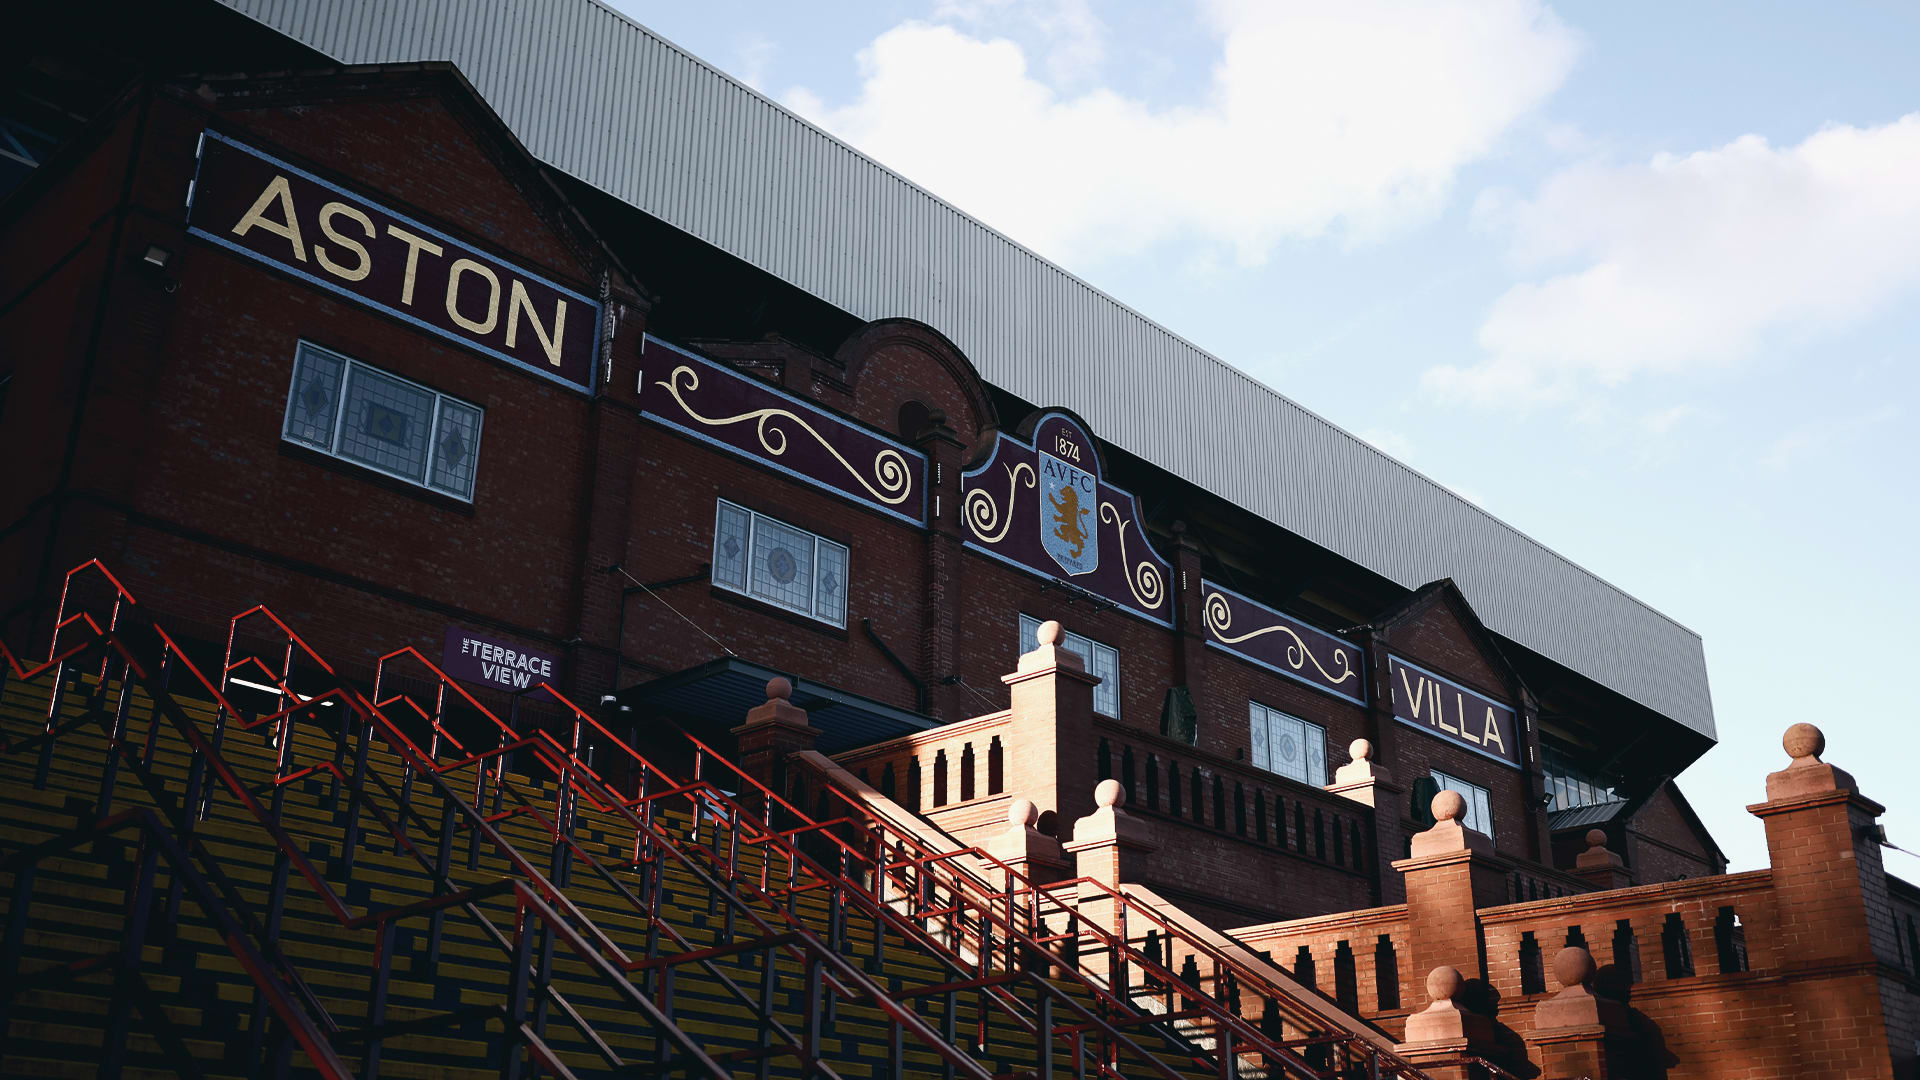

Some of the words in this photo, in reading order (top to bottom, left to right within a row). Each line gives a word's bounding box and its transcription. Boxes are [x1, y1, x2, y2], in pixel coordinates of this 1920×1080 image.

[232, 175, 567, 367] ASTON
[1055, 435, 1081, 463] 1874
[1061, 428, 1072, 438] EST
[1044, 459, 1092, 493] AVFC
[462, 638, 470, 653] THE
[470, 640, 552, 678] TERRACE
[481, 661, 531, 689] VIEW
[1400, 667, 1505, 754] VILLA
